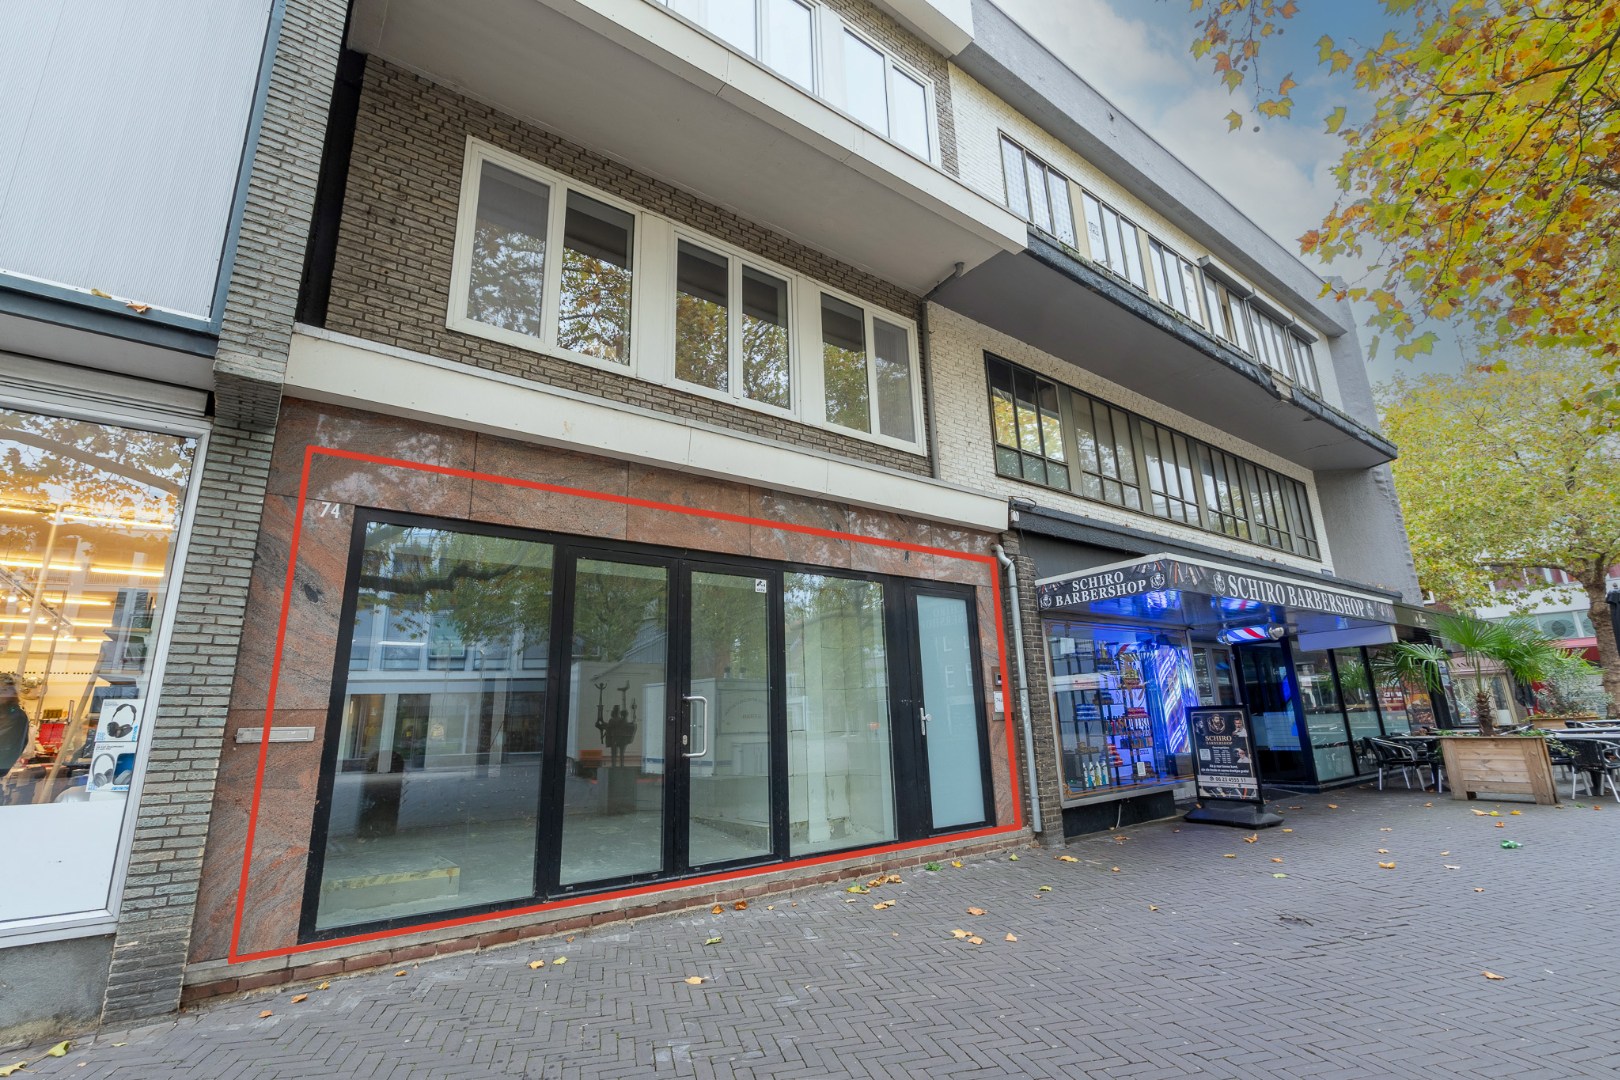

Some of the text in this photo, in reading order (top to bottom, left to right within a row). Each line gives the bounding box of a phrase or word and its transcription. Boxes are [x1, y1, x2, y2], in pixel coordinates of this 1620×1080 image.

[320, 501, 340, 518] 74
[1055, 579, 1147, 607] BARBERSHOP
[1072, 571, 1124, 592] SCHIRO
[1228, 574, 1365, 617] SCHIRO BARBERSHOP
